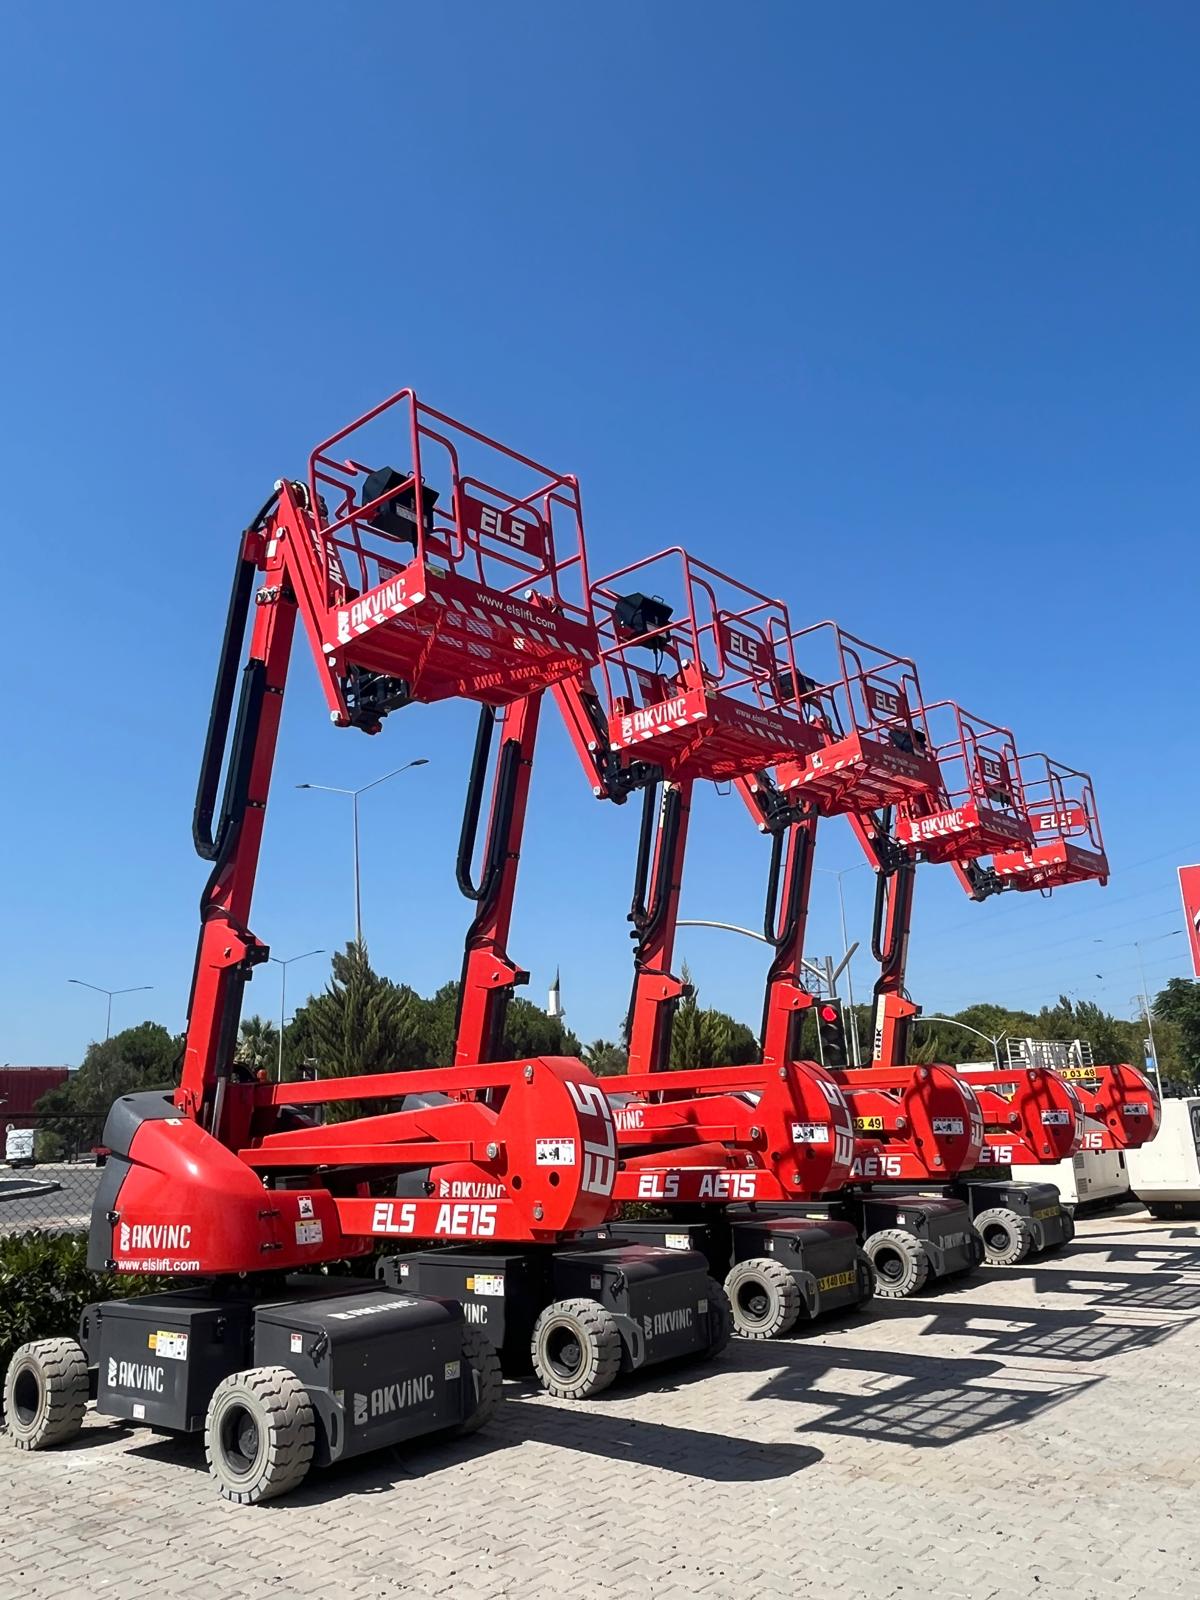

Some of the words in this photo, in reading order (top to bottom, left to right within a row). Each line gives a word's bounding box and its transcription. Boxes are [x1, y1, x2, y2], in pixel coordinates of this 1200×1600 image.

[481, 507, 526, 547] ELS
[476, 592, 557, 631] www.elslift.com
[730, 632, 758, 662] ELS
[875, 691, 898, 713] ELS
[1069, 1070, 1082, 1078] 03
[1084, 1068, 1096, 1077] 49
[815, 1079, 854, 1167] ELS
[867, 1117, 881, 1129] 49
[564, 1080, 617, 1197] ELS
[849, 1156, 901, 1177] AE15
[637, 1175, 680, 1198] ELS
[698, 1173, 757, 1198] AE15
[371, 1203, 417, 1233] ELS
[434, 1203, 498, 1236] AE15
[117, 1258, 200, 1272] www.elslift.com
